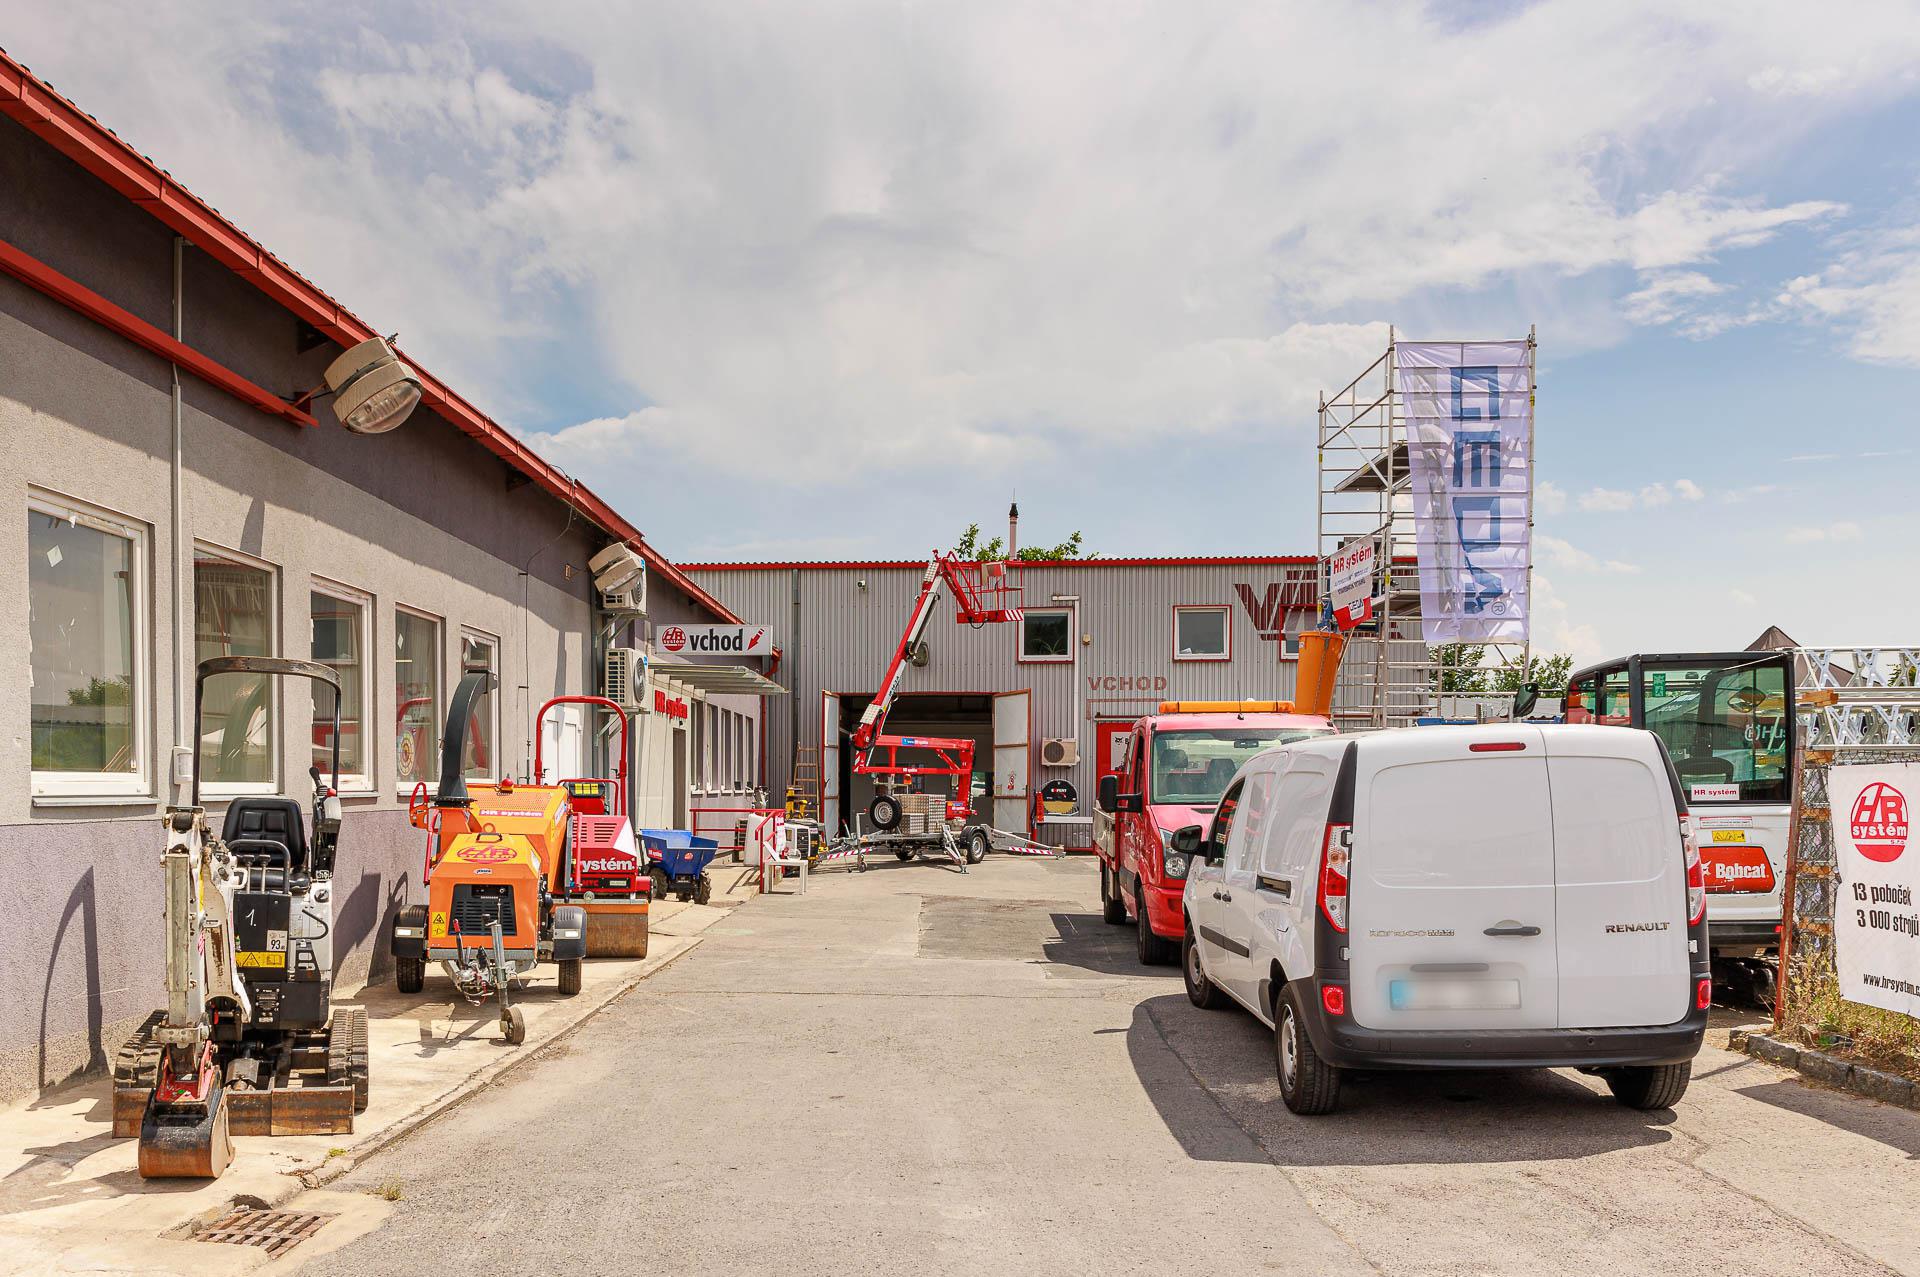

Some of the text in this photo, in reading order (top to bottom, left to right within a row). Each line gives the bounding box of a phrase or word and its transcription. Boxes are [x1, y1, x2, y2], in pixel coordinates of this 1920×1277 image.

[1450, 366, 1503, 614] GEDA
[1333, 545, 1372, 575] HR systém
[690, 628, 743, 651] vchod
[1087, 676, 1168, 691] VCHOD
[1708, 789, 1737, 797] systém
[1853, 783, 1904, 823] HR
[1852, 823, 1907, 839] systém
[1715, 863, 1767, 879] Bobcat
[1852, 882, 1912, 907] 13 poboček
[1605, 922, 1670, 933] RENAULT
[1856, 909, 1920, 938] 3 000 strojů
[271, 939, 281, 950] 93
